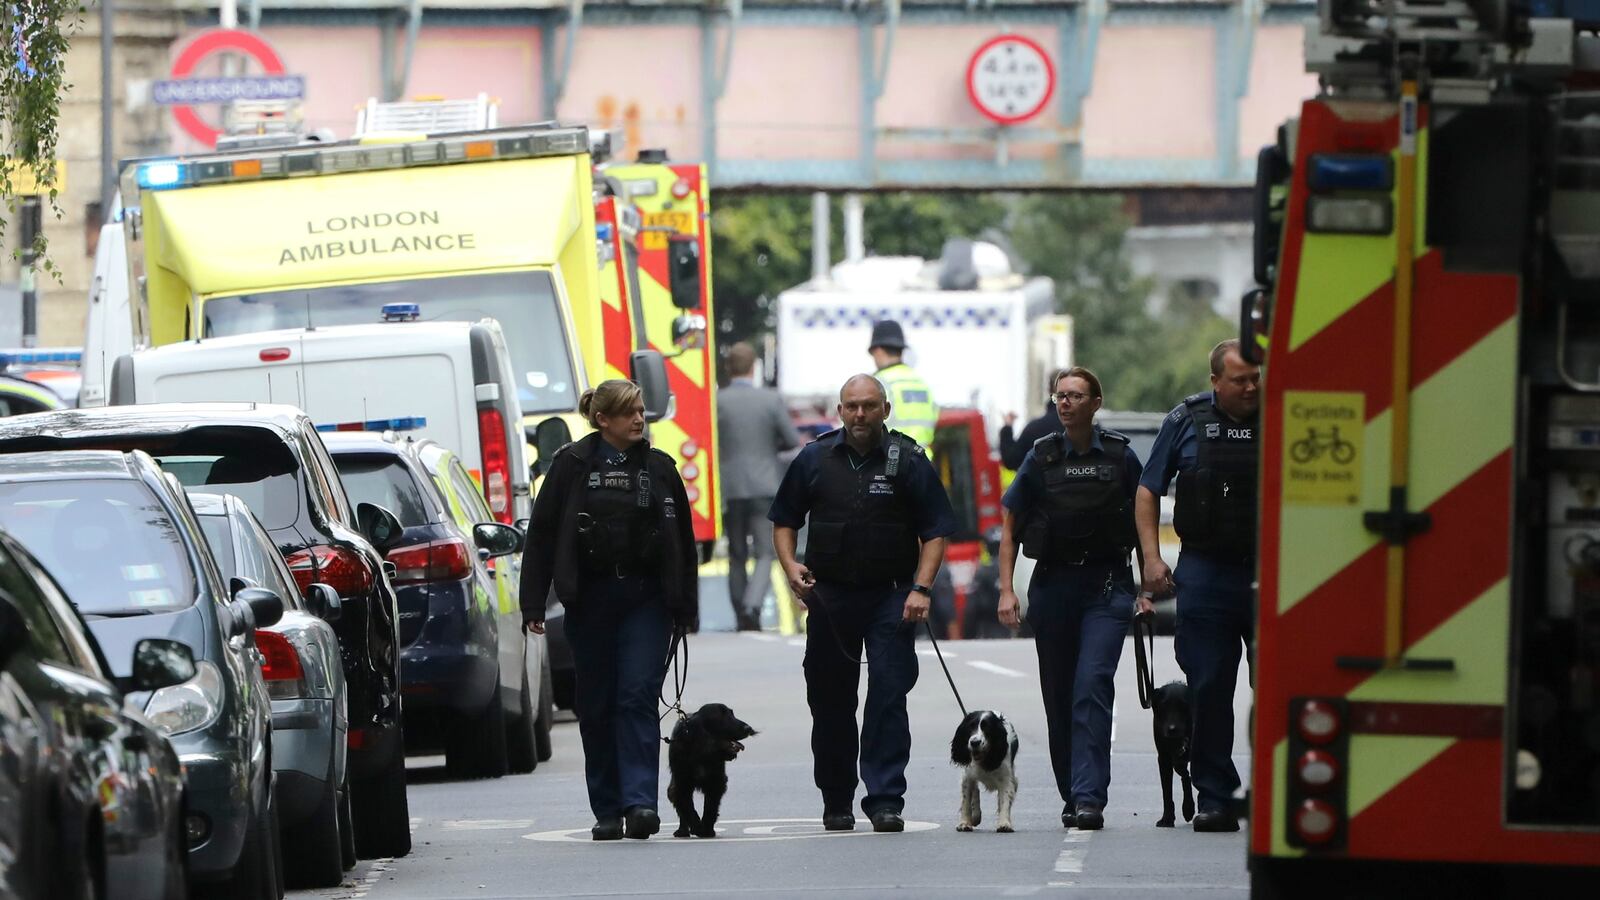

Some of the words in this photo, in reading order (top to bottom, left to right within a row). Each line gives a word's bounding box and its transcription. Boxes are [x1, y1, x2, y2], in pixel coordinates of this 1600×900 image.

[154, 78, 301, 100] UNDERGROUND
[307, 210, 440, 235] LONDON
[278, 233, 477, 266] AMBULANCE
[1290, 403, 1356, 420] Cyclists
[1227, 429, 1252, 439] POLICE
[1066, 467, 1096, 475] POLICE
[604, 478, 630, 489] POLICE
